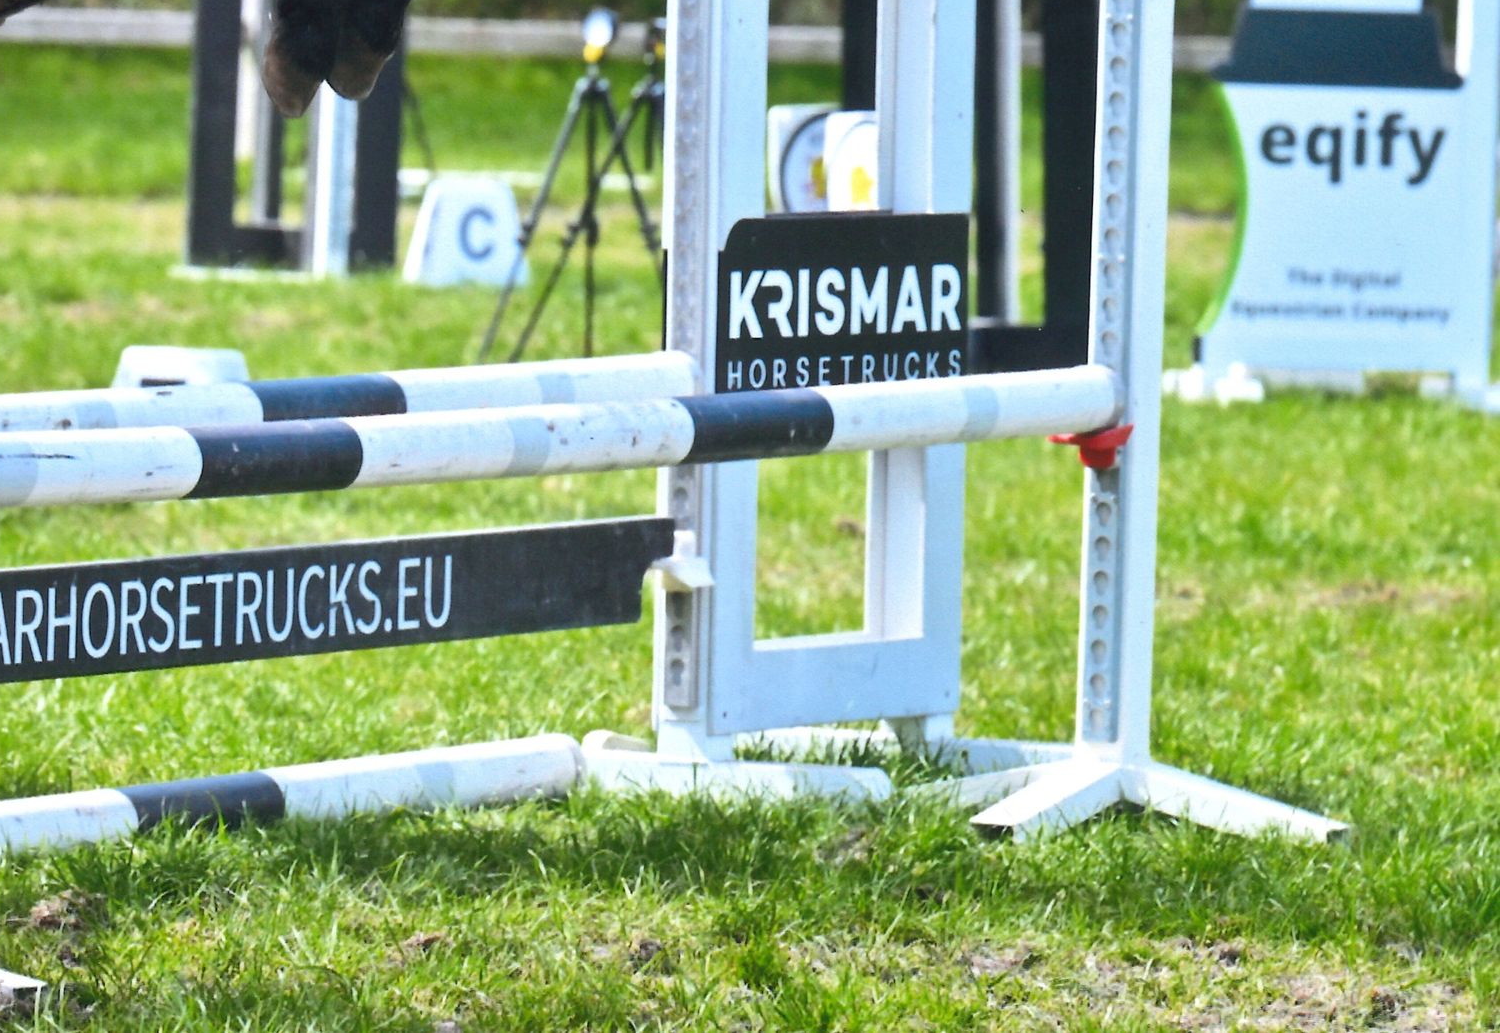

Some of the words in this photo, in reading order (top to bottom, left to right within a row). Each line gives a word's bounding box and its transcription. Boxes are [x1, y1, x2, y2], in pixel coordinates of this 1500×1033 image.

[1260, 110, 1445, 186] eqify
[459, 206, 495, 260] C
[728, 263, 962, 340] KRISMAR
[727, 349, 962, 390] HORSETRUCKS
